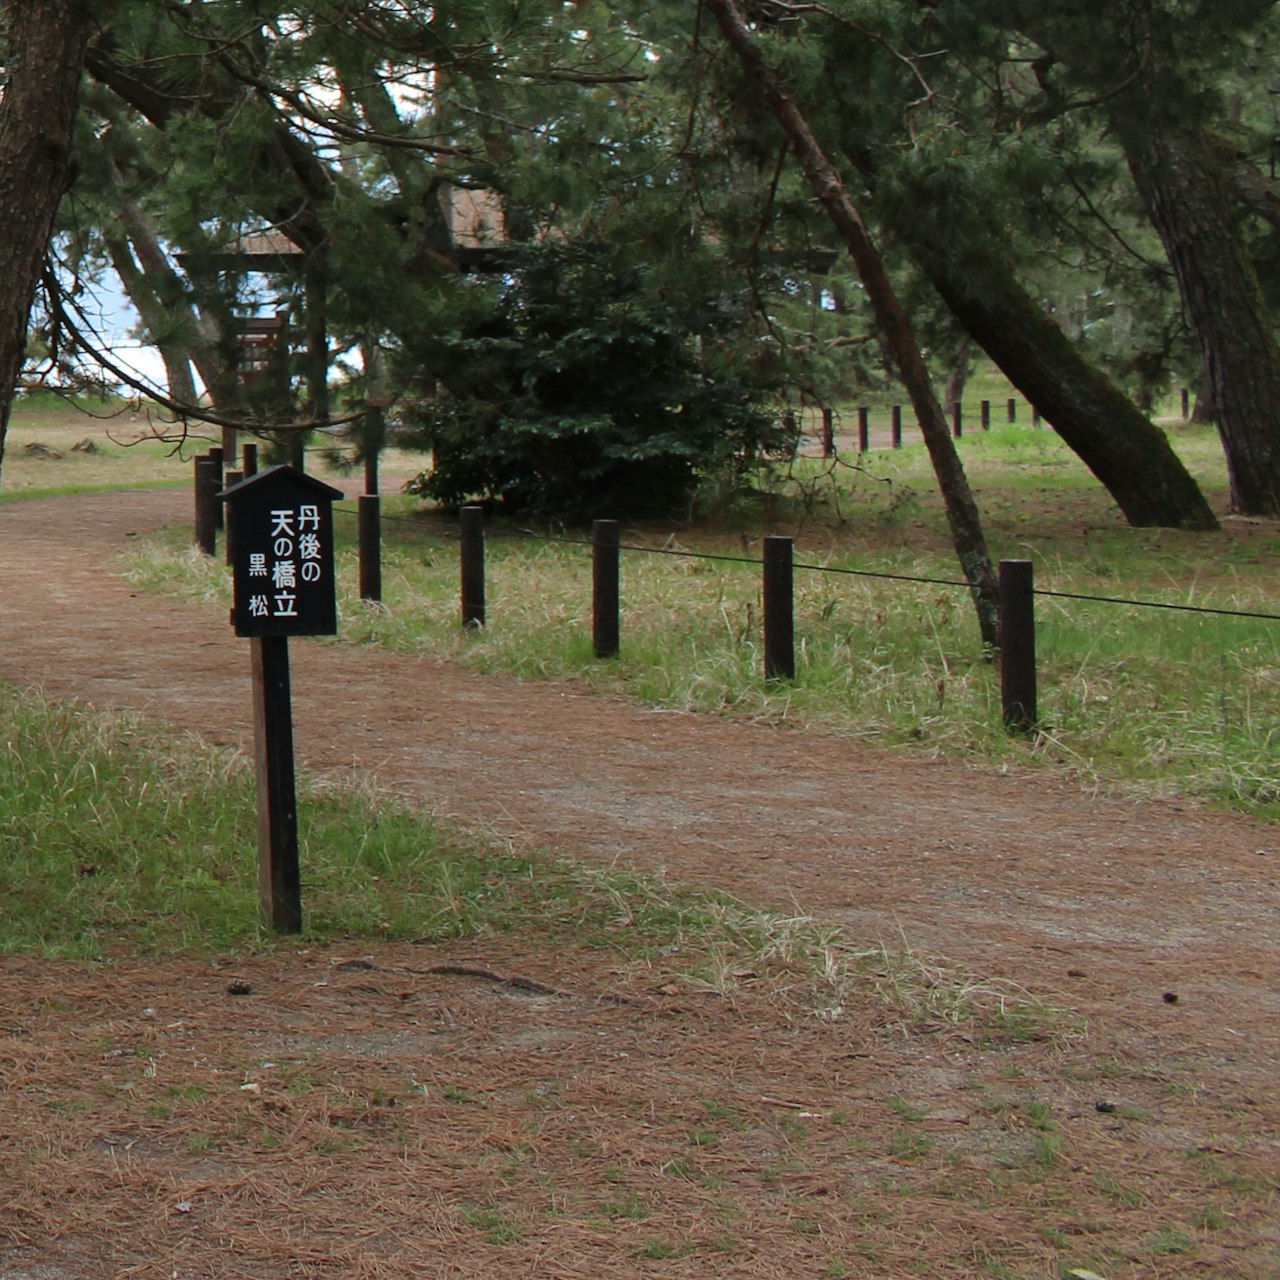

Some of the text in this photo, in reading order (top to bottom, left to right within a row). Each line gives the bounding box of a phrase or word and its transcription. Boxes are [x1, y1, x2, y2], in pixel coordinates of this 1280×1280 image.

[270, 510, 298, 616] 天の橋立
[297, 505, 322, 581] 丹後の
[248, 553, 269, 617] 黒松
